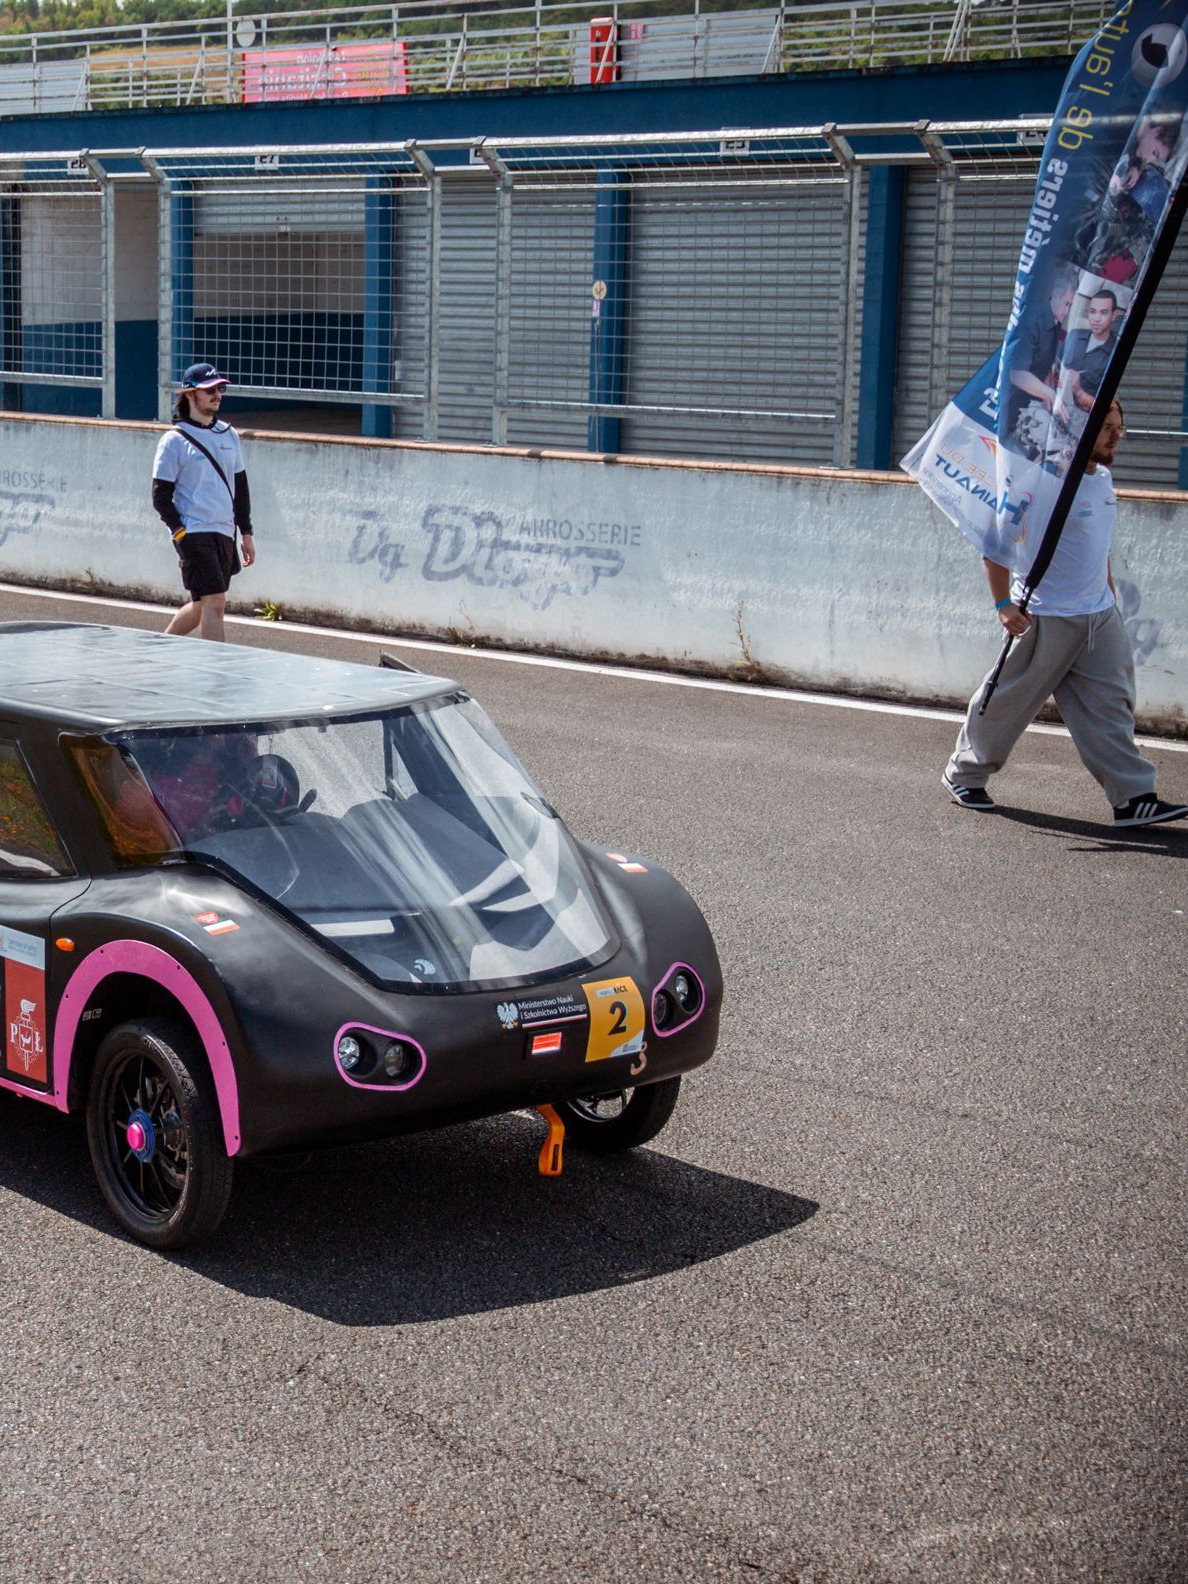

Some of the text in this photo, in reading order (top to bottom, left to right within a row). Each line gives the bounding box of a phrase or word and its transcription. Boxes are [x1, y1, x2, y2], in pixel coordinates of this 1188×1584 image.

[518, 994, 574, 1010] Ministerstwo Nauki
[524, 1004, 558, 1020] Szkolnictwa
[558, 1003, 587, 1017] Wyższego
[607, 1000, 628, 1036] 2
